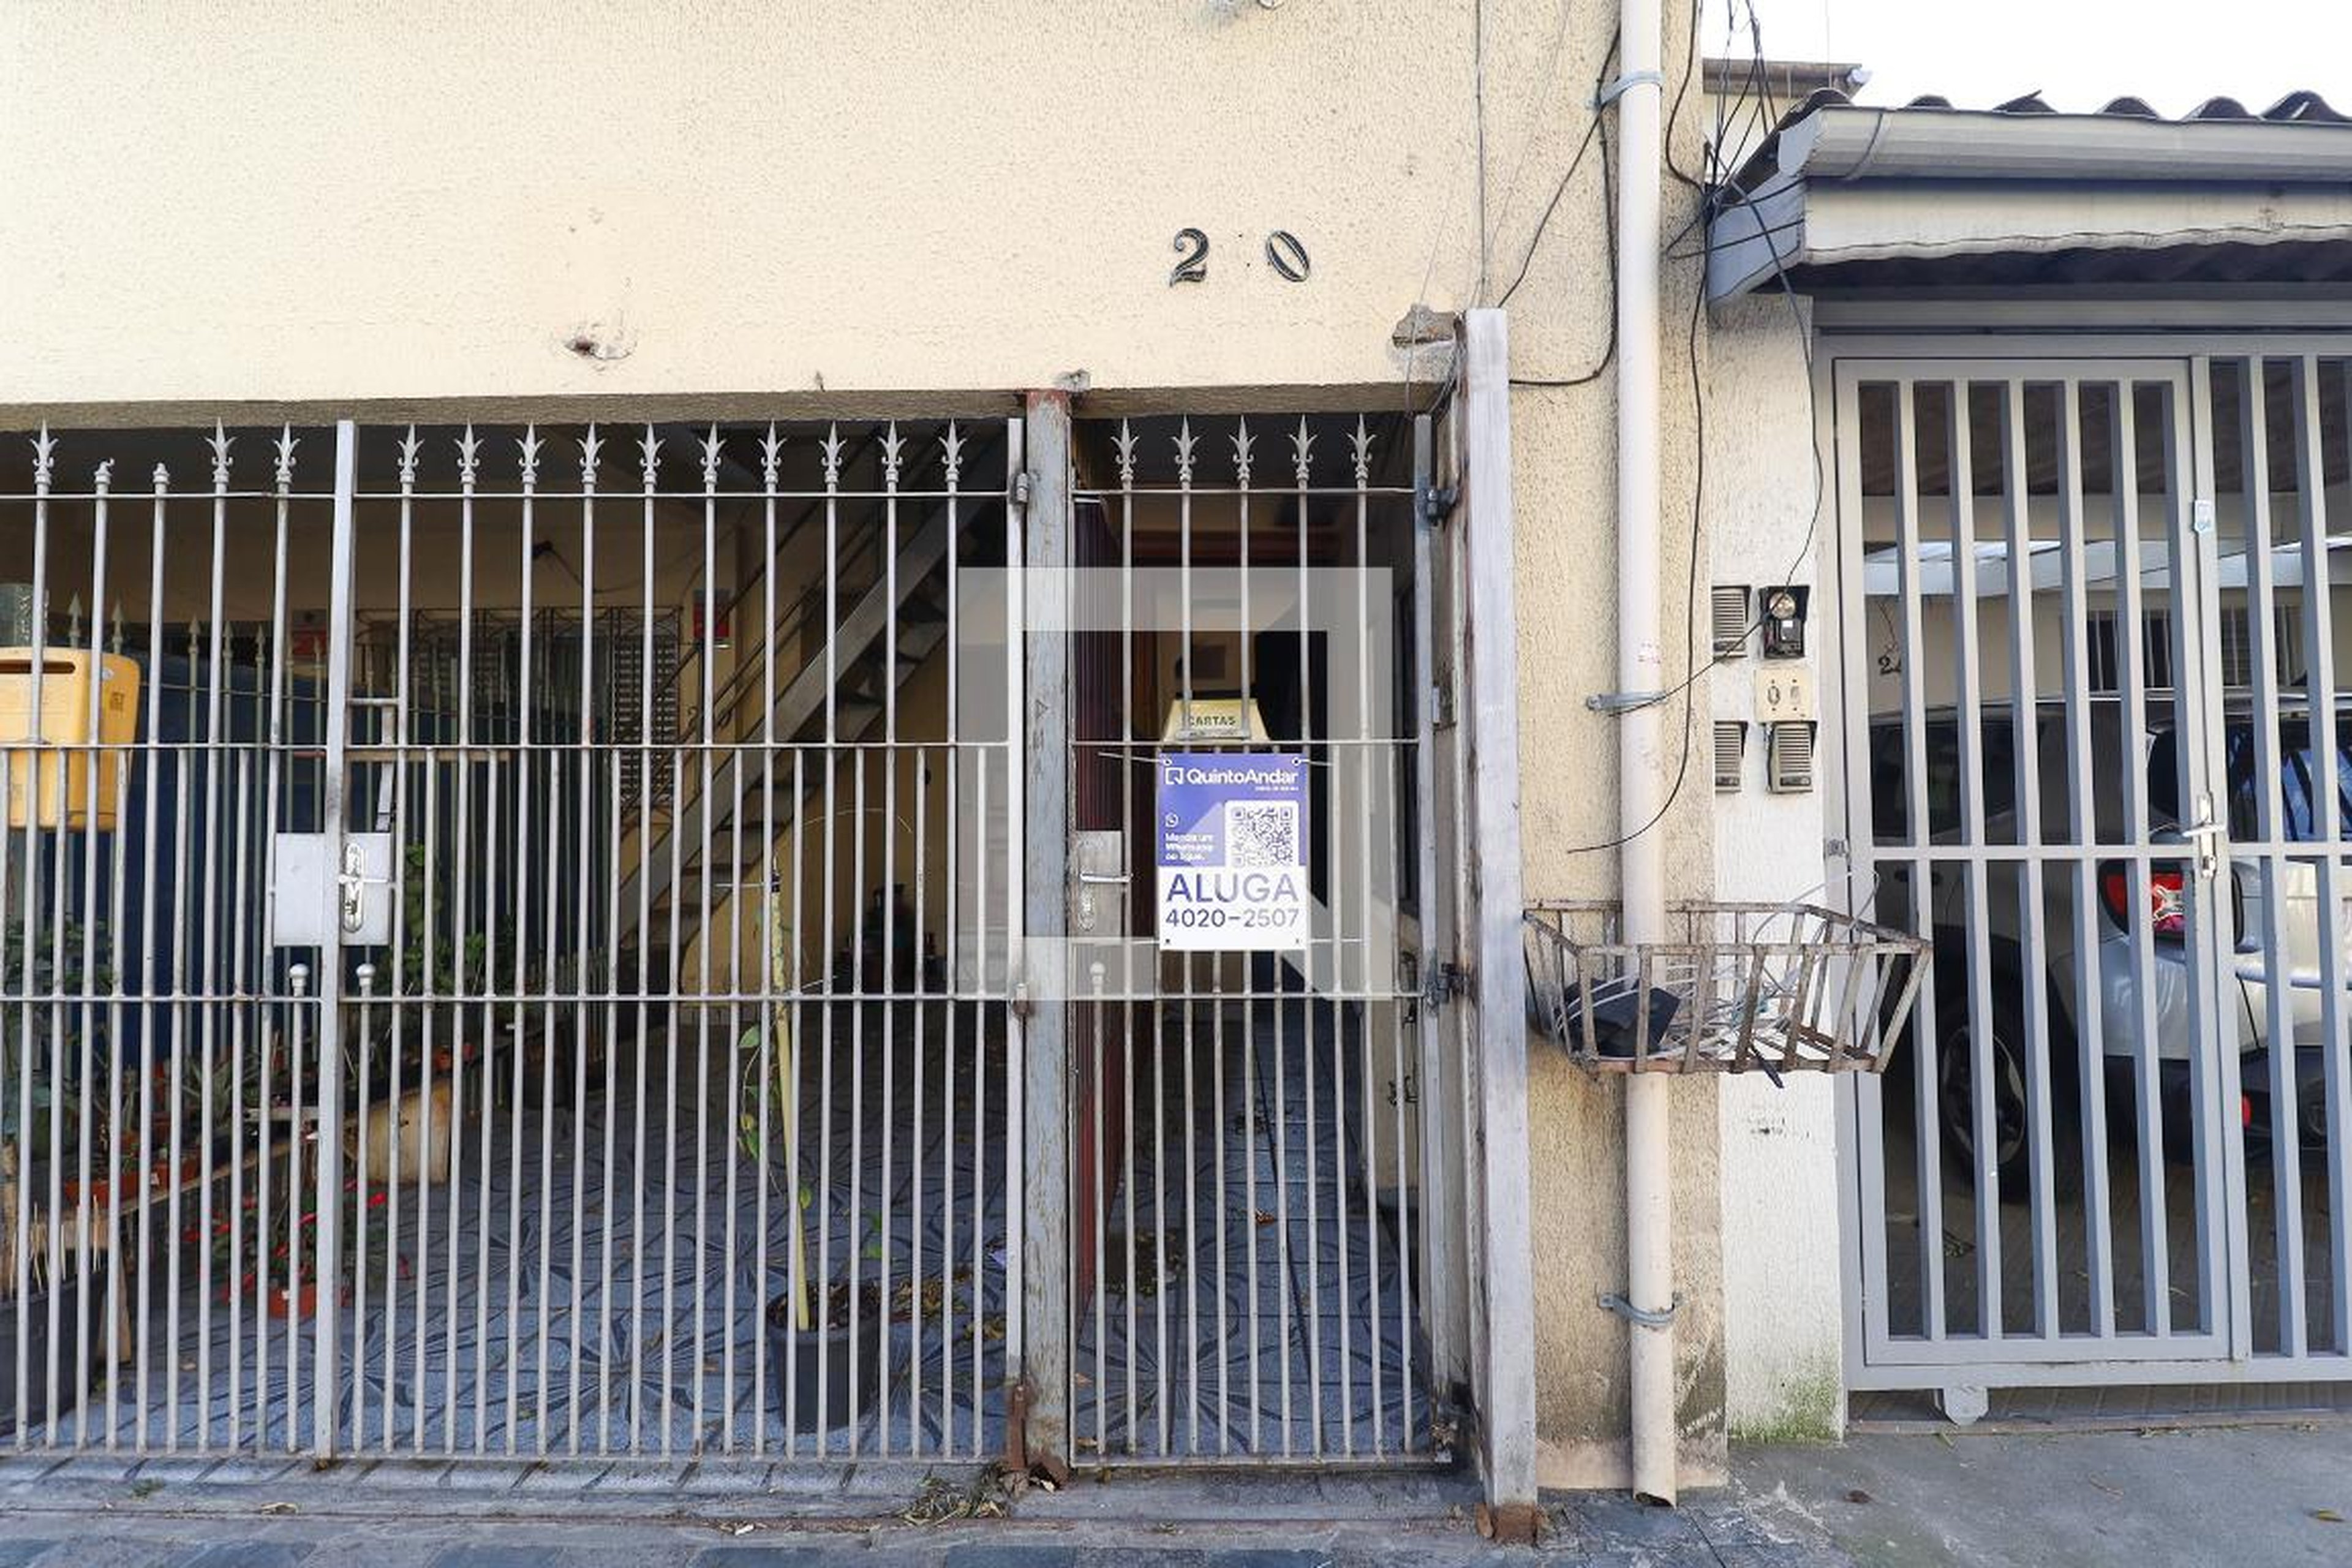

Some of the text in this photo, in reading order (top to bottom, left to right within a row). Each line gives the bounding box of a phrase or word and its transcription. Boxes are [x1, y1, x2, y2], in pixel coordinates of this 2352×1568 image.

[1189, 715, 1237, 726] CARTAS
[1187, 768, 1298, 785] QuintoAndar
[1166, 873, 1298, 902] ALUGA
[1165, 908, 1299, 927] 4020-2507
